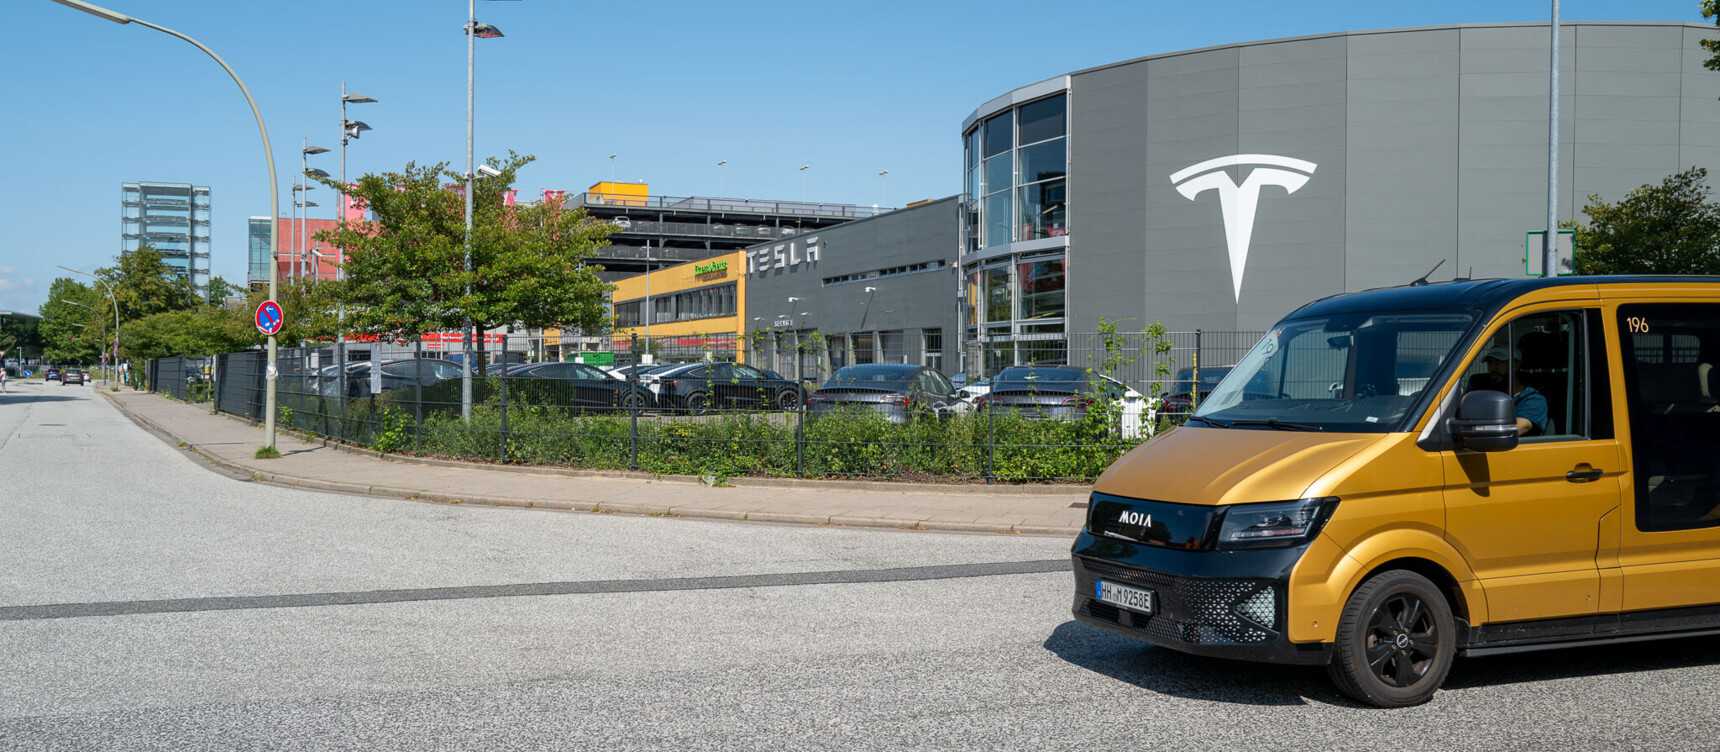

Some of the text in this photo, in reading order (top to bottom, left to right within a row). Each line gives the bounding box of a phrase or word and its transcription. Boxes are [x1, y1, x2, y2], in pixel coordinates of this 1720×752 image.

[746, 236, 819, 273] TESLA
[1626, 316, 1649, 333] 196
[1118, 510, 1152, 528] MOIA
[1101, 583, 1111, 600] HH
[1123, 589, 1150, 609] 9258E
